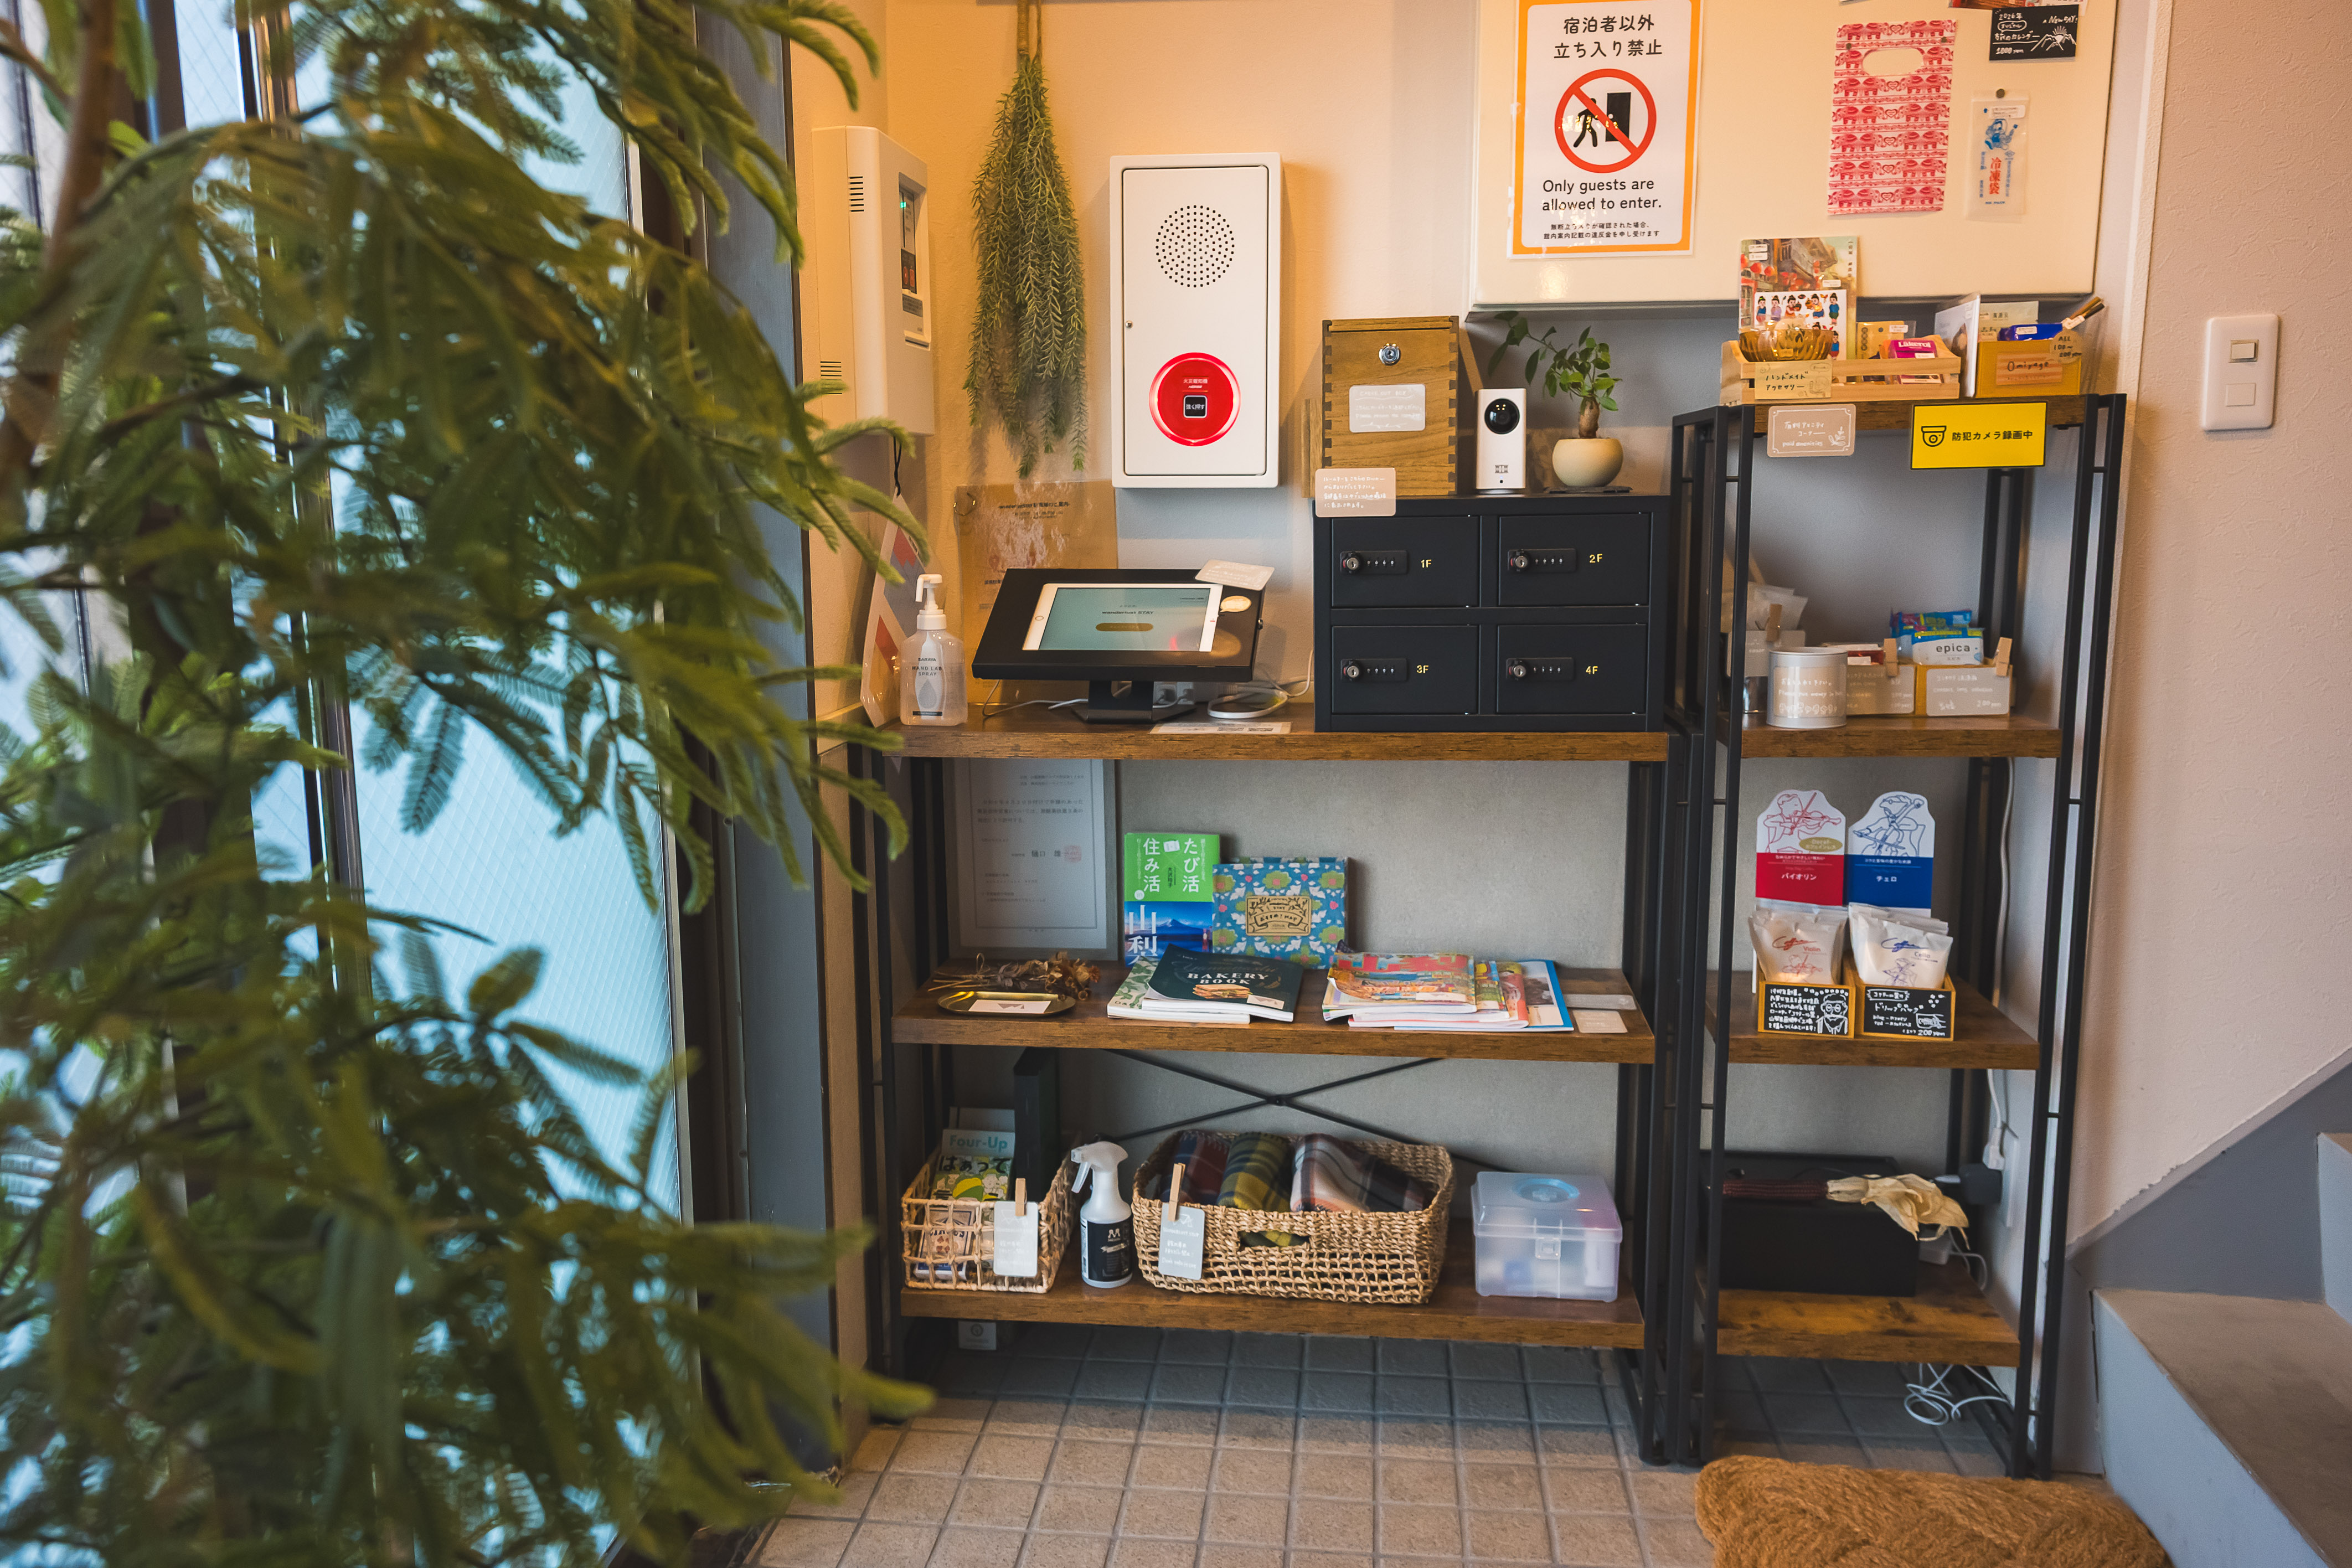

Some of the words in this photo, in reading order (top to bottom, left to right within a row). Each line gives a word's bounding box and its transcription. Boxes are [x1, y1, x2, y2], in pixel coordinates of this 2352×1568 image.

[1563, 14, 1655, 34] 宿泊者以外
[1554, 39, 1663, 59] 立ち入り禁止
[1543, 179, 1574, 194] Only
[1580, 179, 1626, 194] guests
[1632, 180, 1654, 189] are
[1542, 198, 1595, 210] allowed
[1601, 198, 1615, 209] to
[1620, 197, 1662, 208] enter.
[2008, 361, 2049, 372] Omiyage
[1766, 371, 1808, 381] ハンドメイド
[1952, 430, 2033, 441] 防犯カメラ録画中
[1421, 560, 1432, 568] 1F
[1589, 554, 1602, 563] 2F
[1936, 643, 1971, 654] epica
[1417, 666, 1429, 674] 3F
[1586, 667, 1598, 675] 4F
[1143, 838, 1160, 893] 住み活
[1183, 838, 1200, 893] たび活
[950, 1135, 1008, 1153] Four-Up
